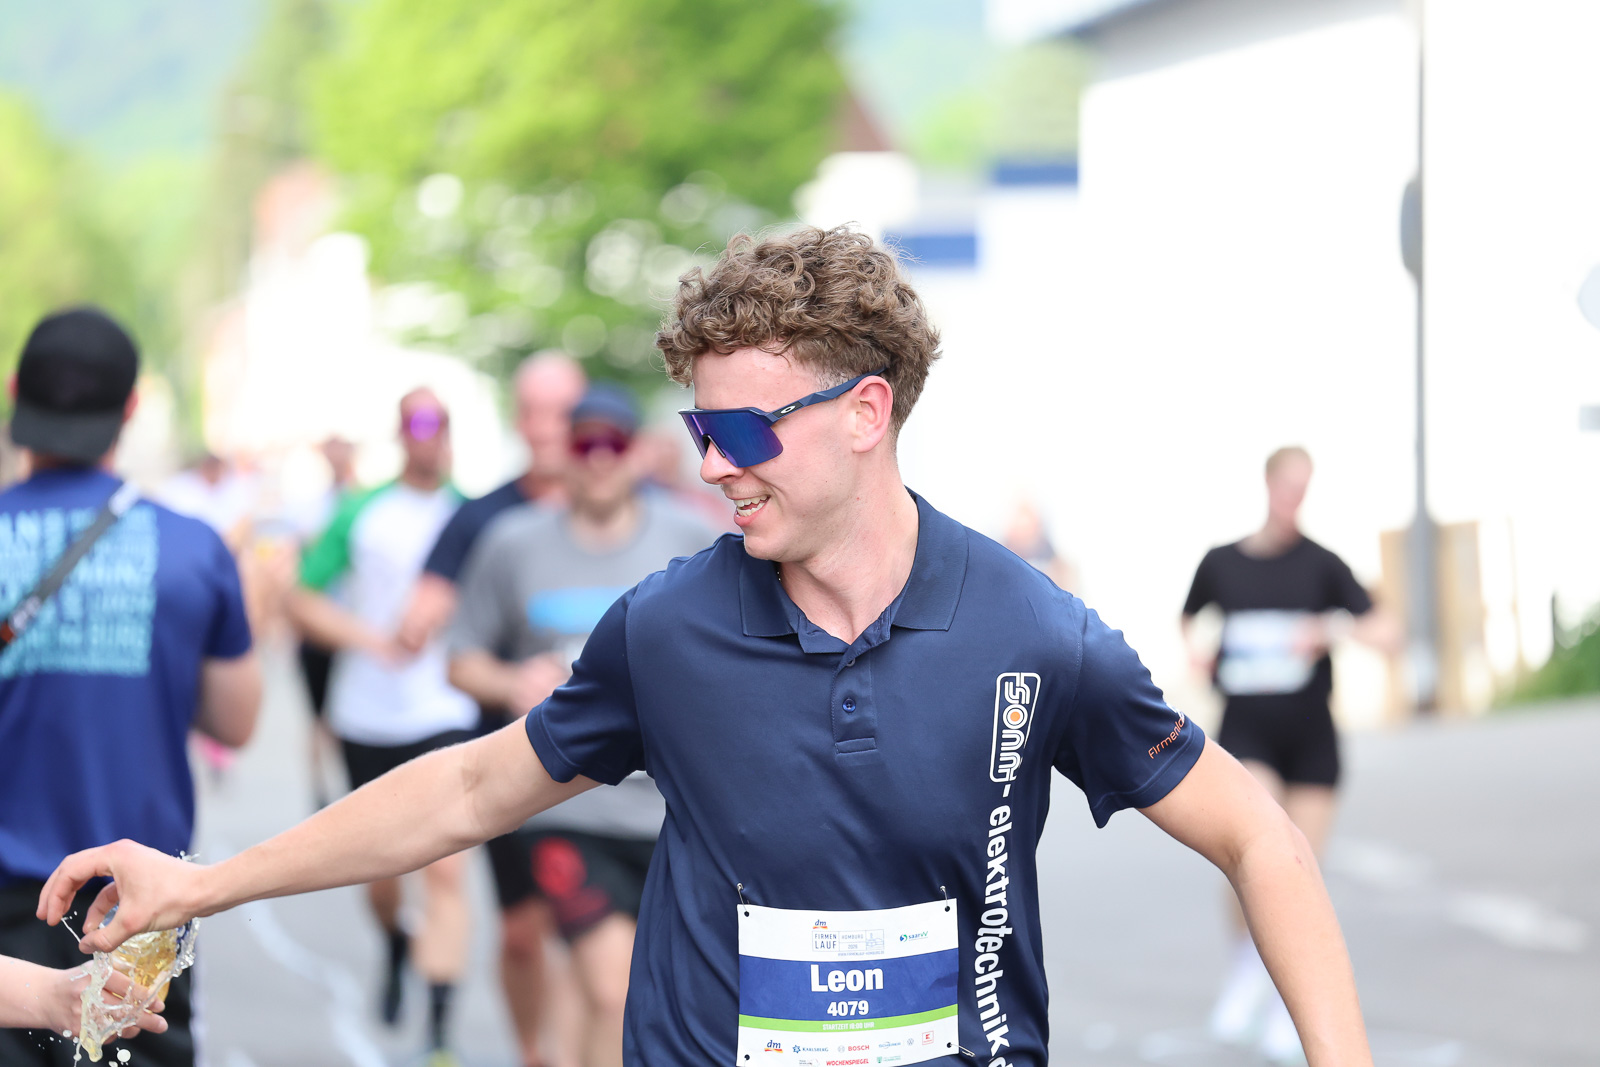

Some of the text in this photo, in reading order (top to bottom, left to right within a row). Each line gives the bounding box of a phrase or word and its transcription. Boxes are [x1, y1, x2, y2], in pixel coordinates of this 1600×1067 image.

[815, 941, 837, 949] LAUF
[810, 964, 884, 993] Leon
[827, 1000, 869, 1017] 4079
[822, 1023, 849, 1031] STARTZEIT
[766, 1040, 781, 1049] dm
[826, 1058, 869, 1067] WOCHENSPIEGEL
